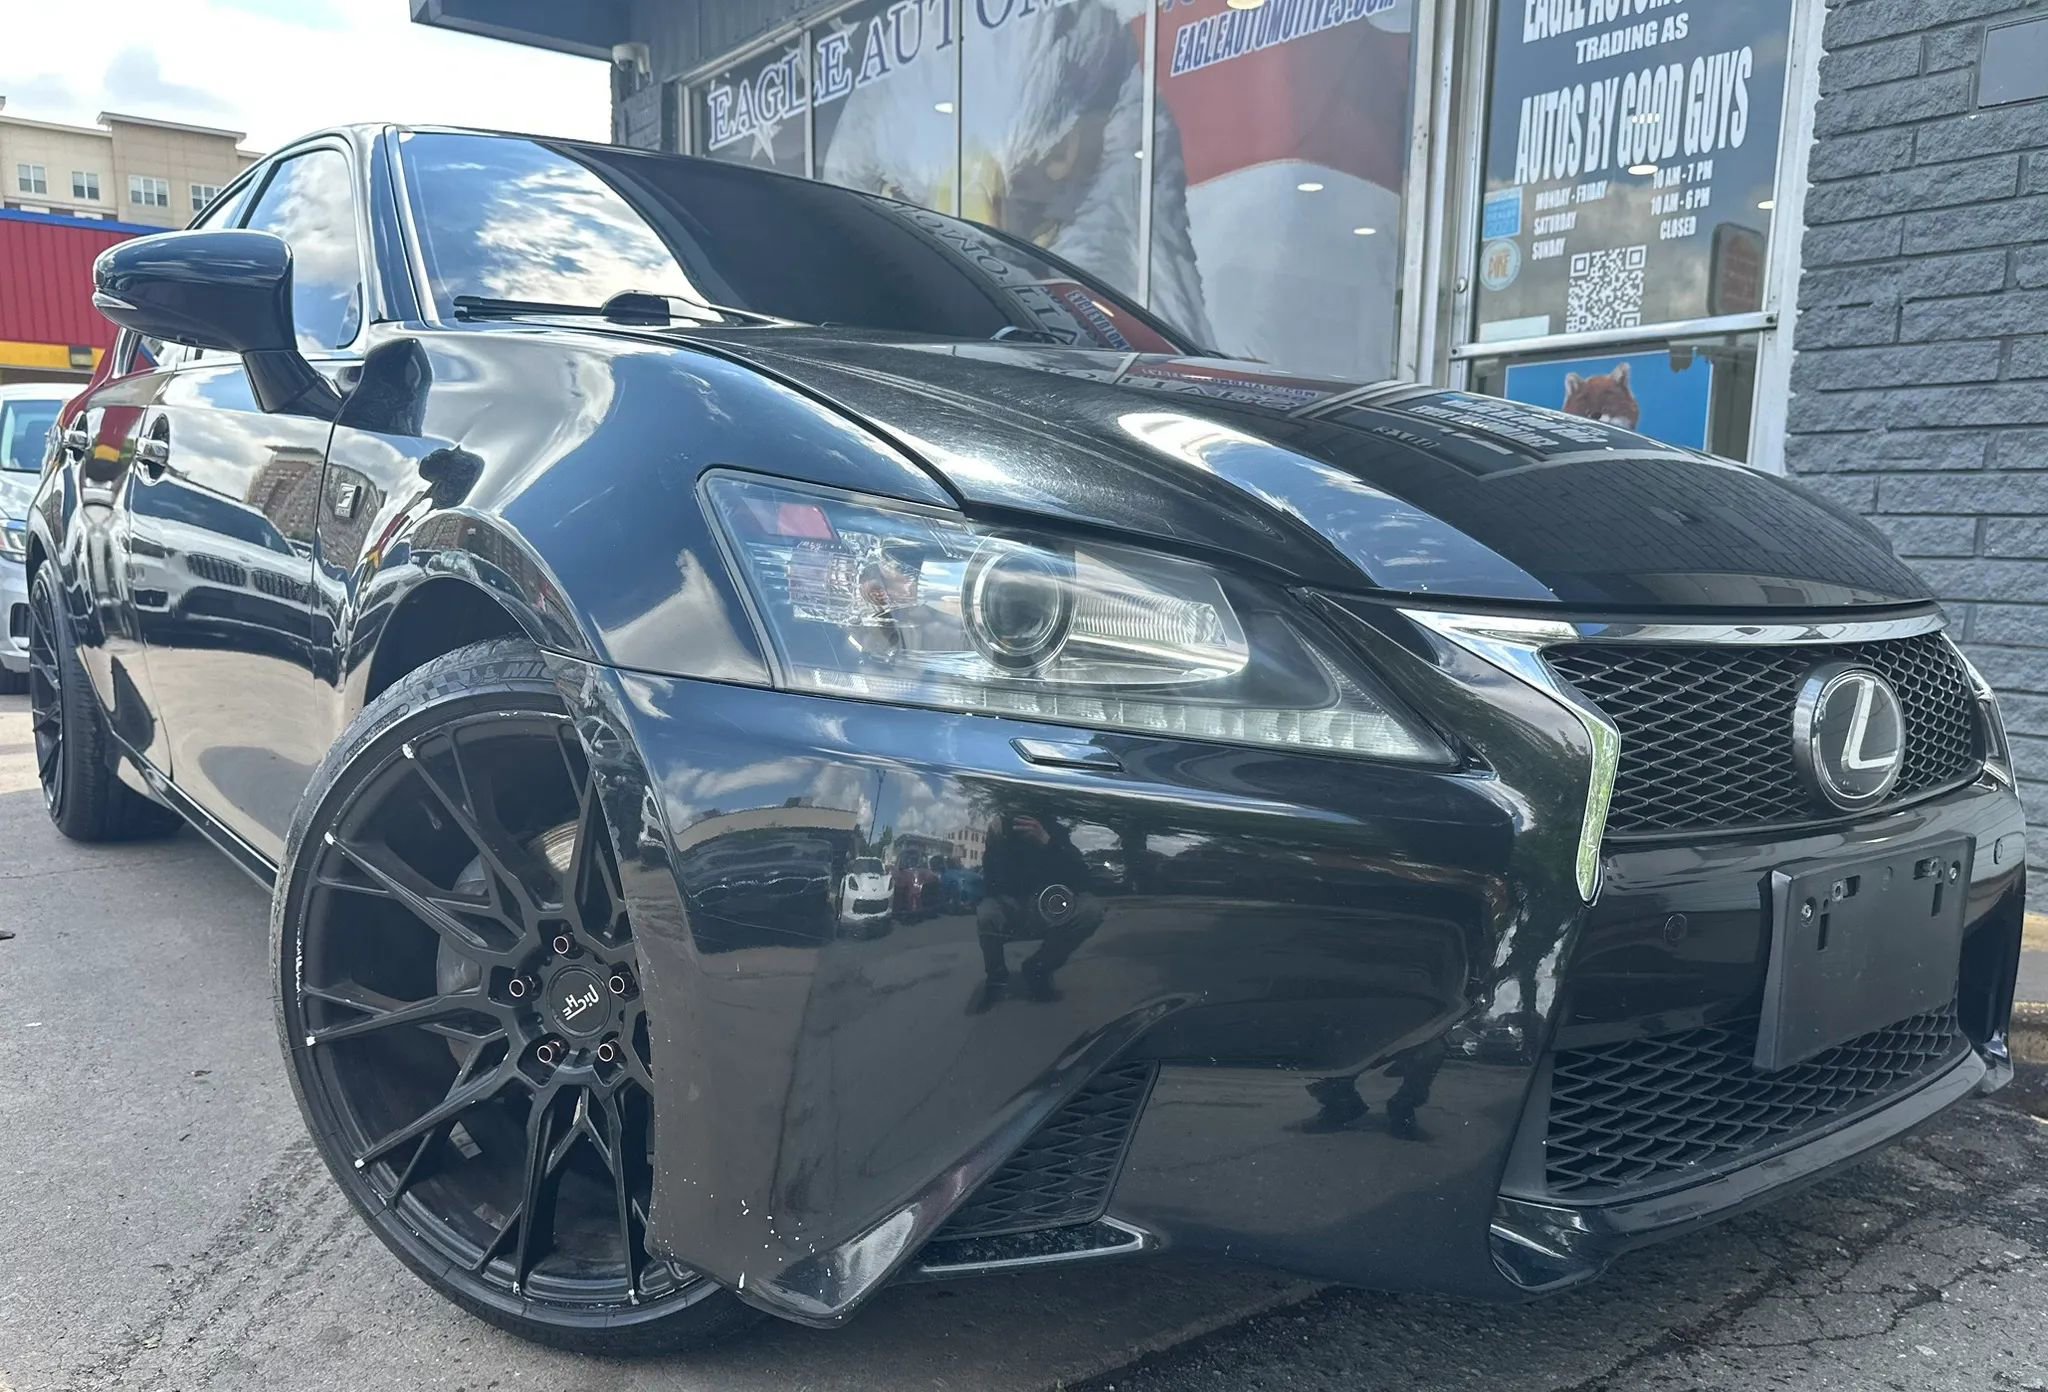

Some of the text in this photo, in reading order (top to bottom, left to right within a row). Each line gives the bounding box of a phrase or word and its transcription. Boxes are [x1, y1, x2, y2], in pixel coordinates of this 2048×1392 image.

[1576, 20, 1658, 64] TRADING
[1661, 12, 1689, 43] AS
[707, 31, 852, 150] EAGLE
[1514, 46, 1753, 185] AUTOS BY GOOD GUYS
[1665, 165, 1681, 187] AM
[1687, 163, 1694, 183] 7
[1696, 159, 1713, 182] PM
[1535, 186, 1571, 212] MONDAY
[1662, 192, 1679, 214] AM
[1694, 186, 1710, 209] PM
[1534, 211, 1577, 236] SATURDAY
[1660, 215, 1696, 240] CLOSED
[1532, 236, 1566, 261] SUNDAY
